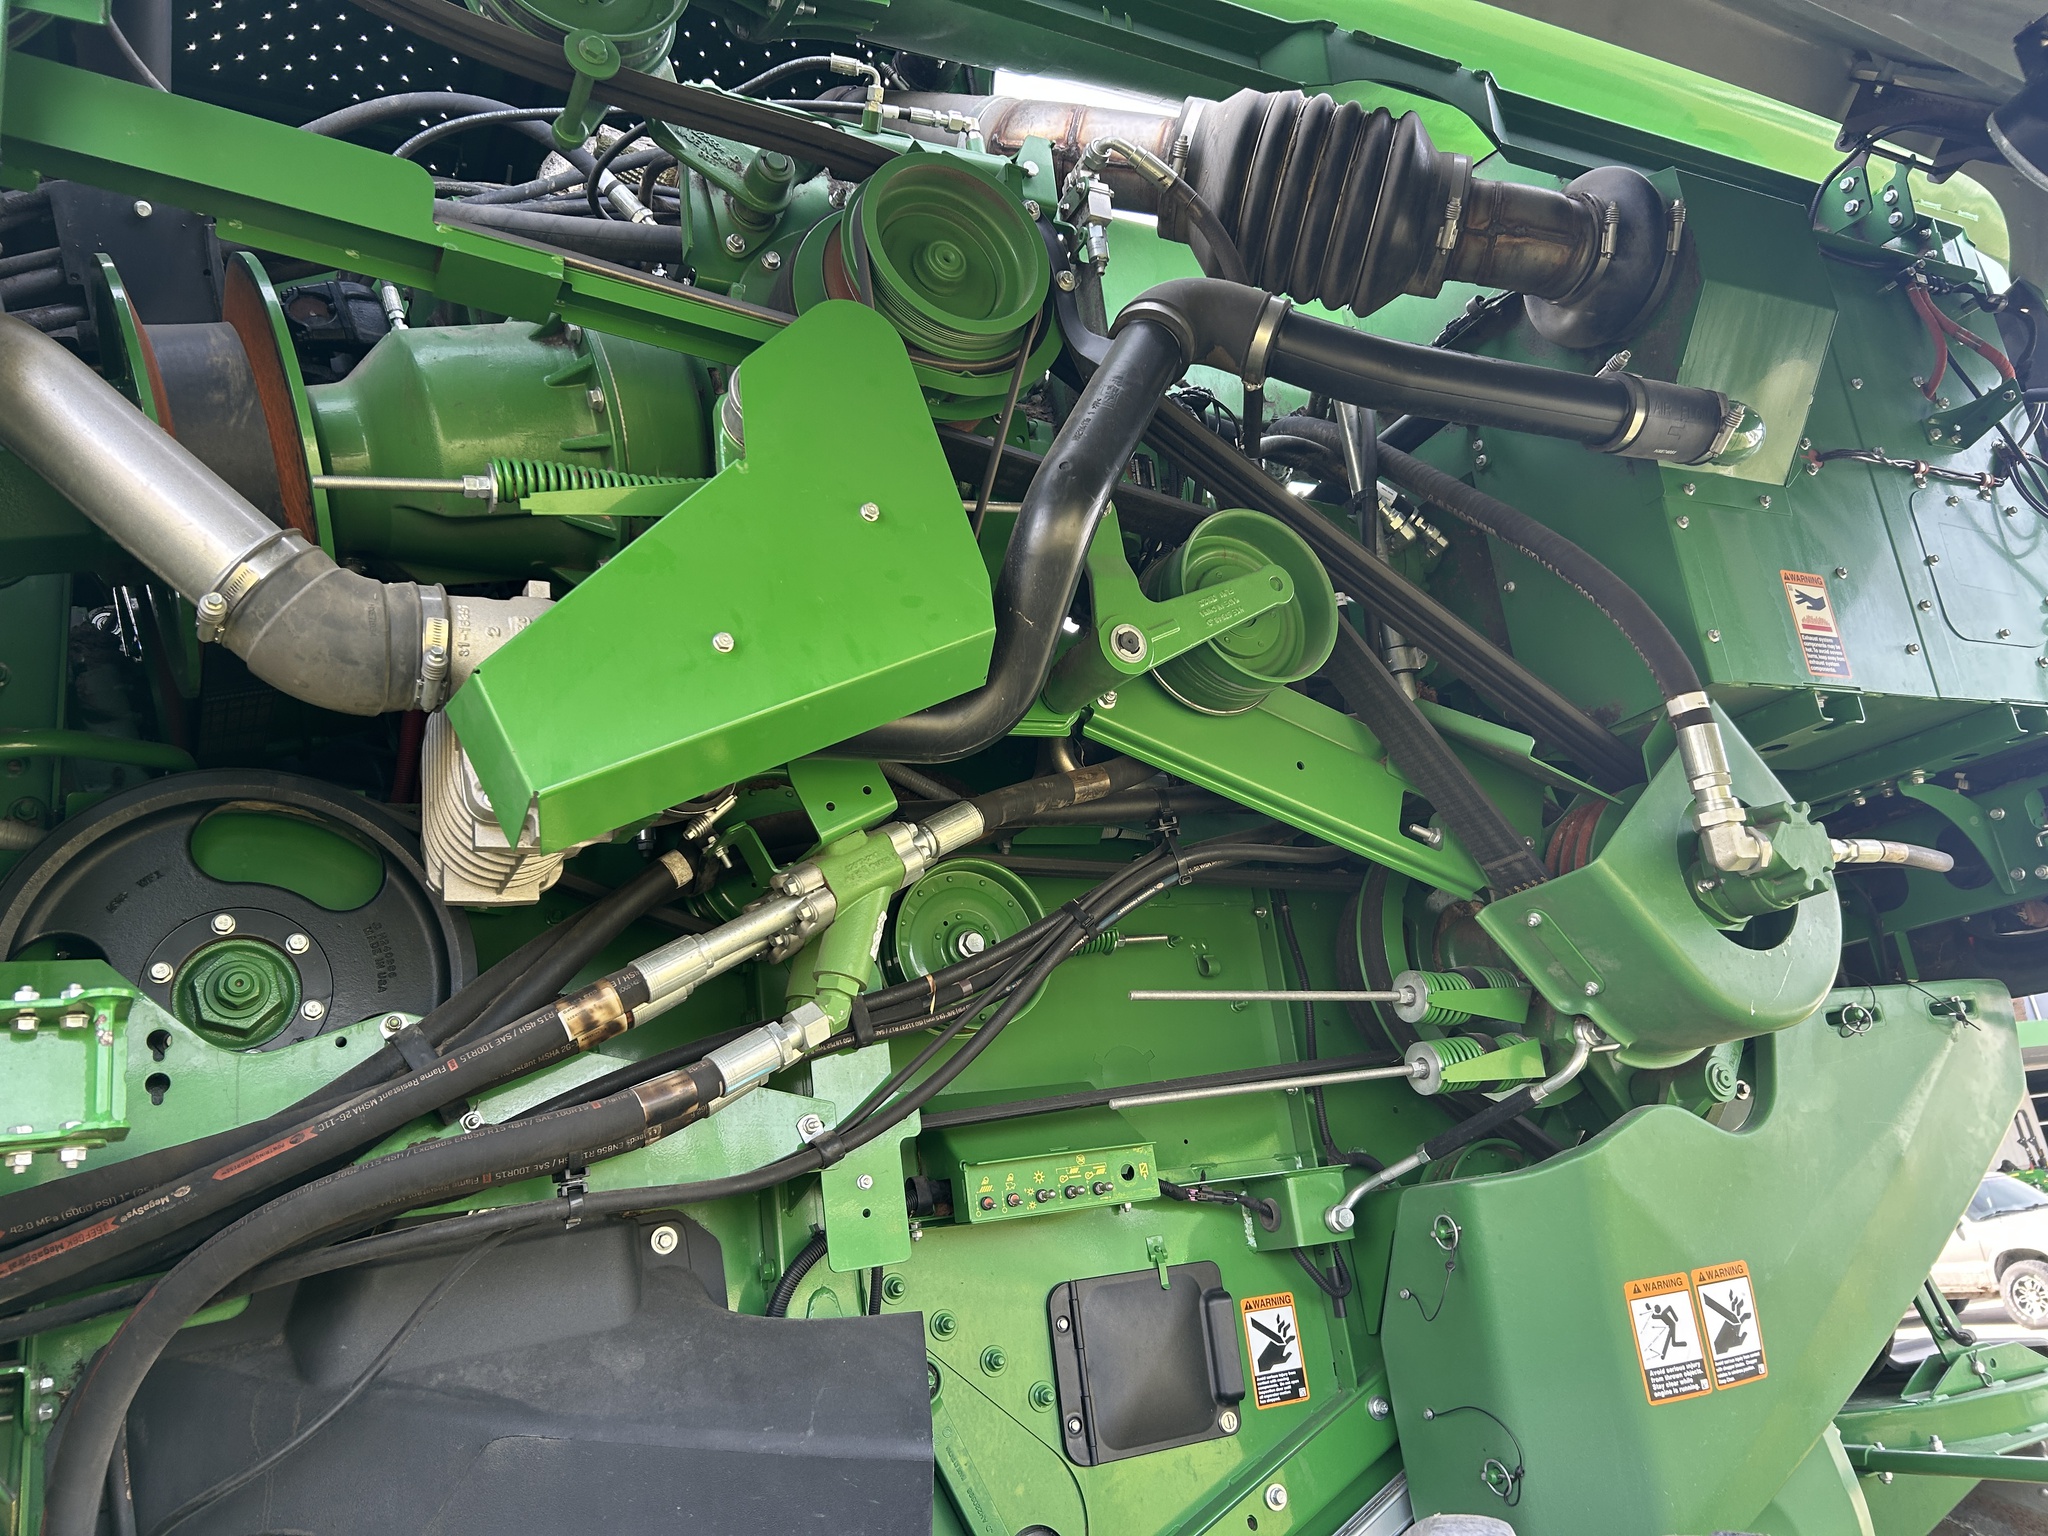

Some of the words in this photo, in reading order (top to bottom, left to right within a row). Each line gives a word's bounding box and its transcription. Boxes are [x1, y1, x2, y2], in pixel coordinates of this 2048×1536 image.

[1653, 403, 1672, 417] AIR
[1788, 573, 1823, 586] WARNING
[1803, 641, 1827, 649] components
[363, 926, 382, 956] MADE
[375, 958, 386, 970] IN
[377, 972, 388, 994] USA
[519, 1021, 538, 1034] 4SH
[496, 1033, 513, 1048] SAE
[459, 1042, 494, 1063] 100R15
[420, 1065, 447, 1082] Flame
[379, 1077, 420, 1104] Resistant
[352, 1096, 379, 1115] MSHA
[317, 1110, 352, 1132] 2G-11C
[597, 1141, 624, 1156] EN856
[496, 1165, 531, 1181] 100R15
[533, 1162, 551, 1172] SAE
[9, 1221, 34, 1235] 42.0
[36, 1215, 59, 1227] MPa
[1706, 1264, 1744, 1281] WARNING
[1642, 1277, 1683, 1293] WARNING
[1252, 1294, 1292, 1310] WARNING
[1649, 1367, 1666, 1377] Avoid
[1666, 1363, 1686, 1373] serious
[1686, 1361, 1701, 1371] injury
[1650, 1375, 1664, 1384] from
[1664, 1372, 1683, 1381] thrown
[1683, 1368, 1704, 1379] objects.
[1652, 1382, 1665, 1392] Stay
[1665, 1379, 1679, 1387] clear
[1679, 1377, 1694, 1385] while
[1654, 1389, 1673, 1398] engine
[1679, 1383, 1701, 1393] running.
